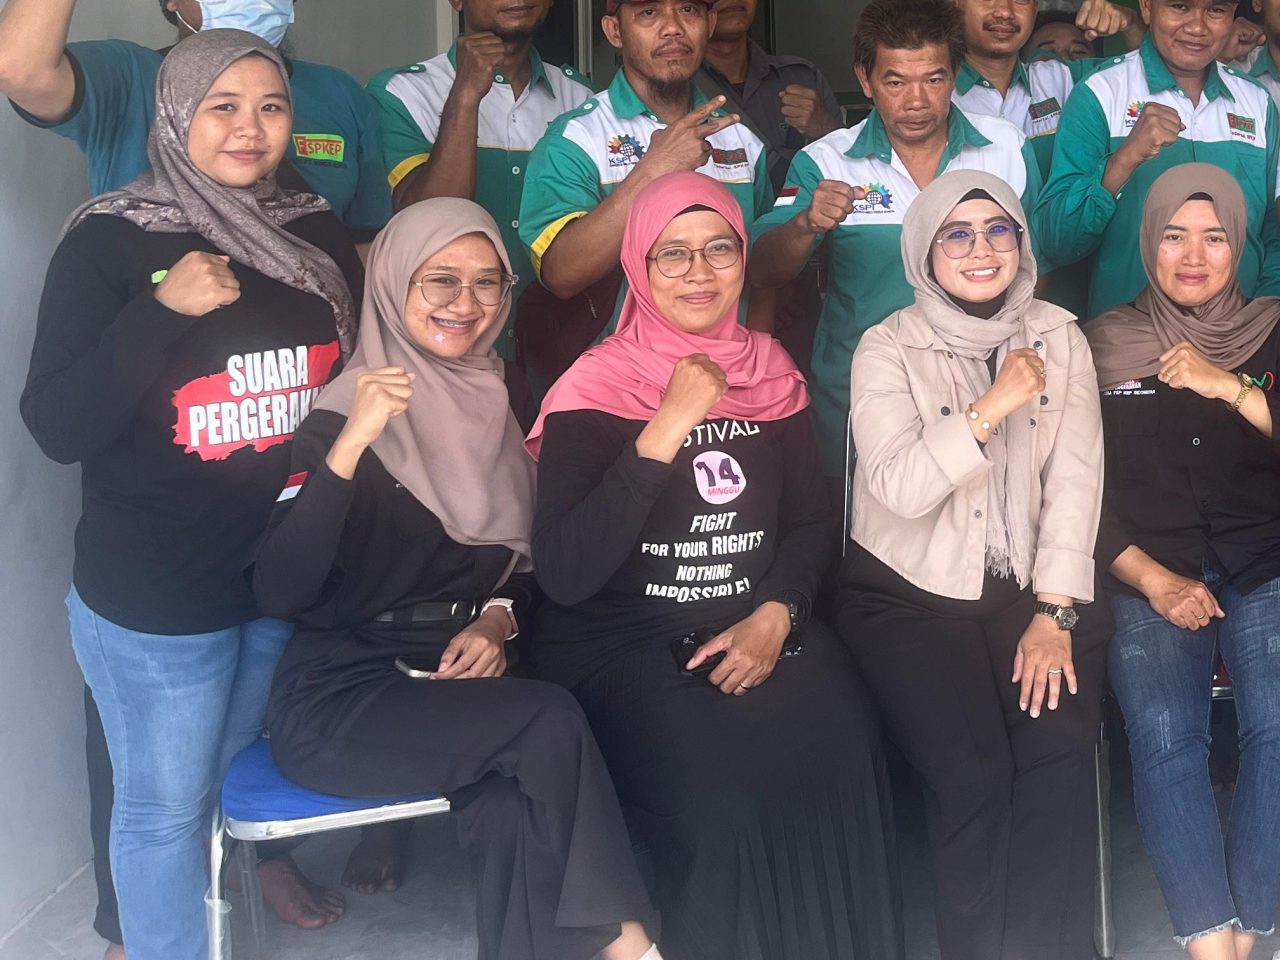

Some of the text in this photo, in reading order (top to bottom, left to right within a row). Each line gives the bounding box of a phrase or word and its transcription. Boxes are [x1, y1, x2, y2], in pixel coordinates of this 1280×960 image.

[294, 136, 342, 156] FSPKEP
[227, 345, 309, 397] SUARA
[188, 384, 325, 448] PERGERAK
[683, 419, 760, 448] STIVAL
[695, 457, 741, 487] 14
[707, 486, 740, 496] MINGGU
[689, 511, 737, 533] FIGHT
[641, 542, 669, 557] FOR
[673, 541, 708, 558] YOUR
[675, 563, 733, 582] NOTHING
